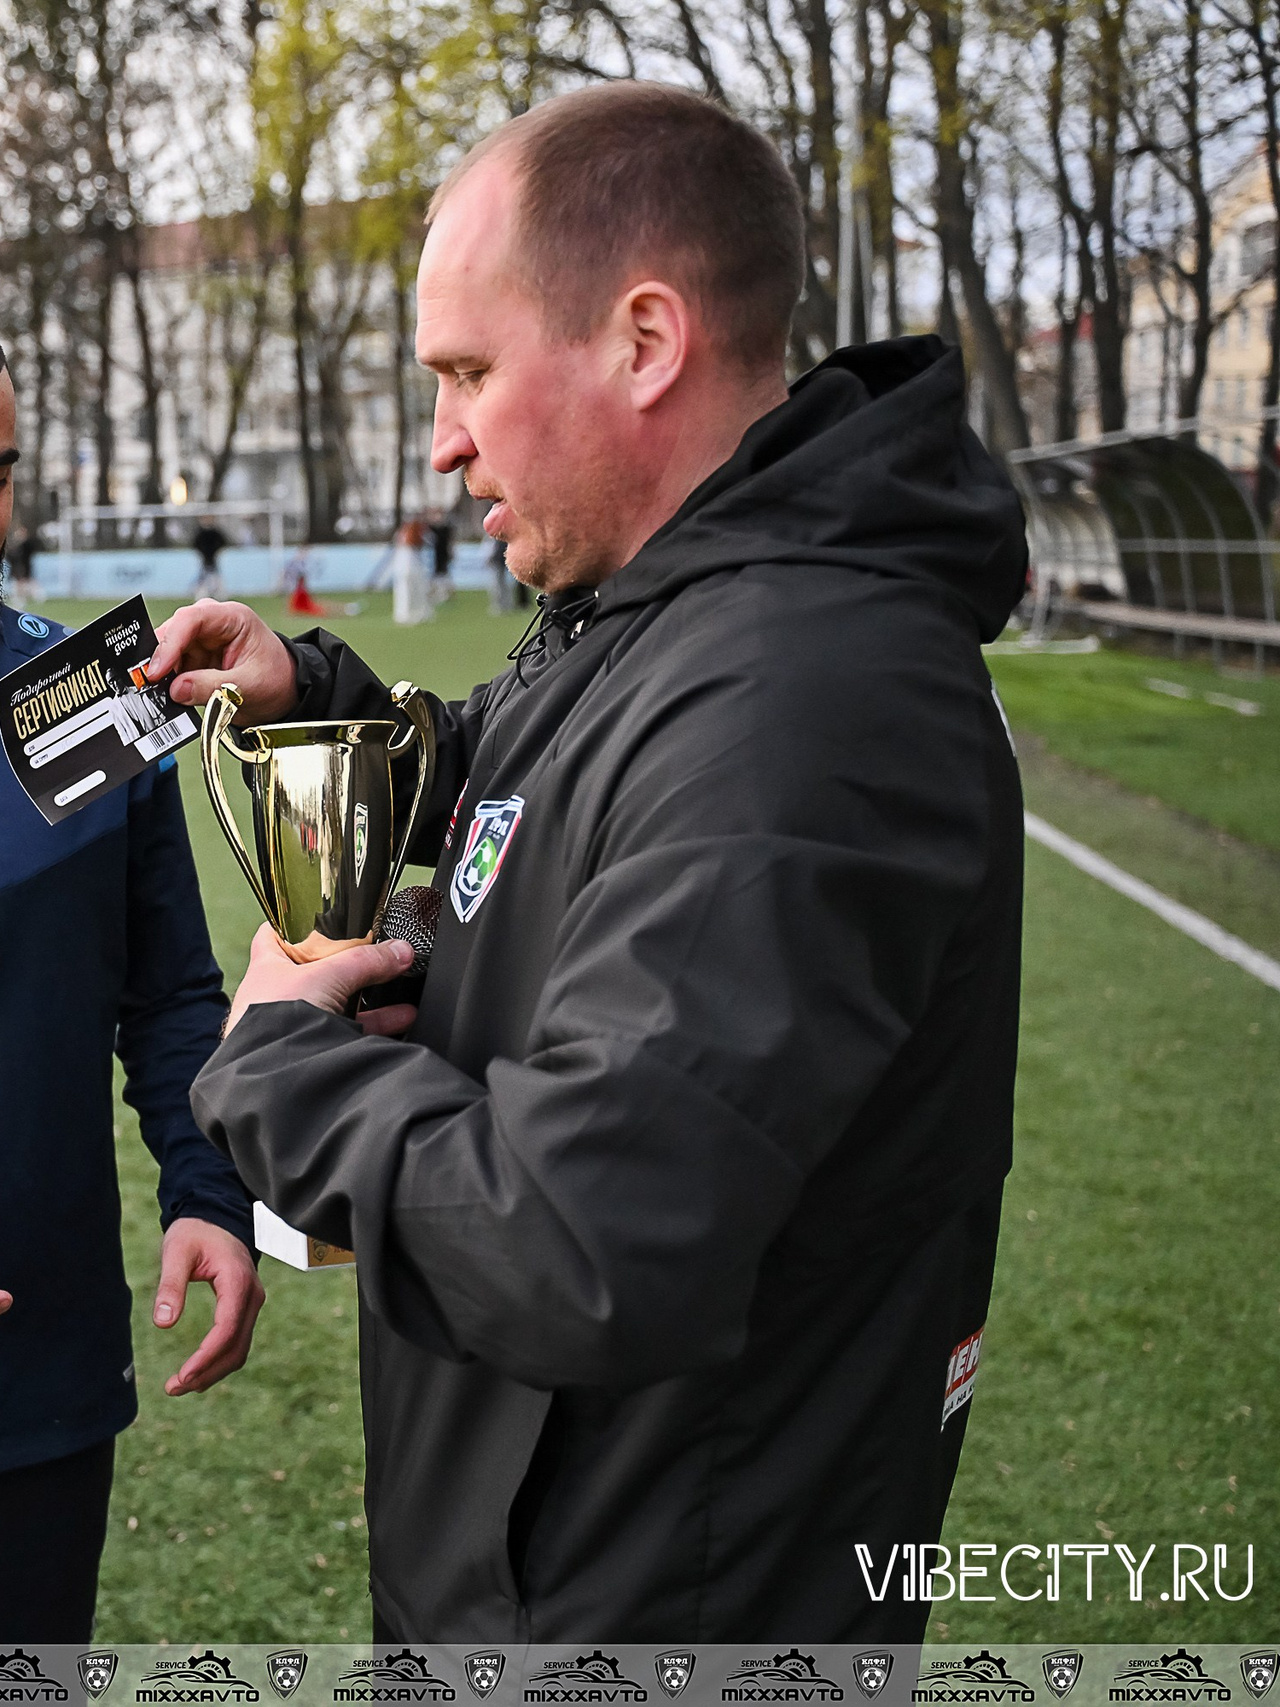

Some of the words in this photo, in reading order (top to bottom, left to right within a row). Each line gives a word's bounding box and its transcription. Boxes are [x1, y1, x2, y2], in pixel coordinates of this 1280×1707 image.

[114, 633, 138, 656] двор
[10, 662, 71, 706] Подарочный
[13, 659, 108, 740] СЕРТИФИКАТ
